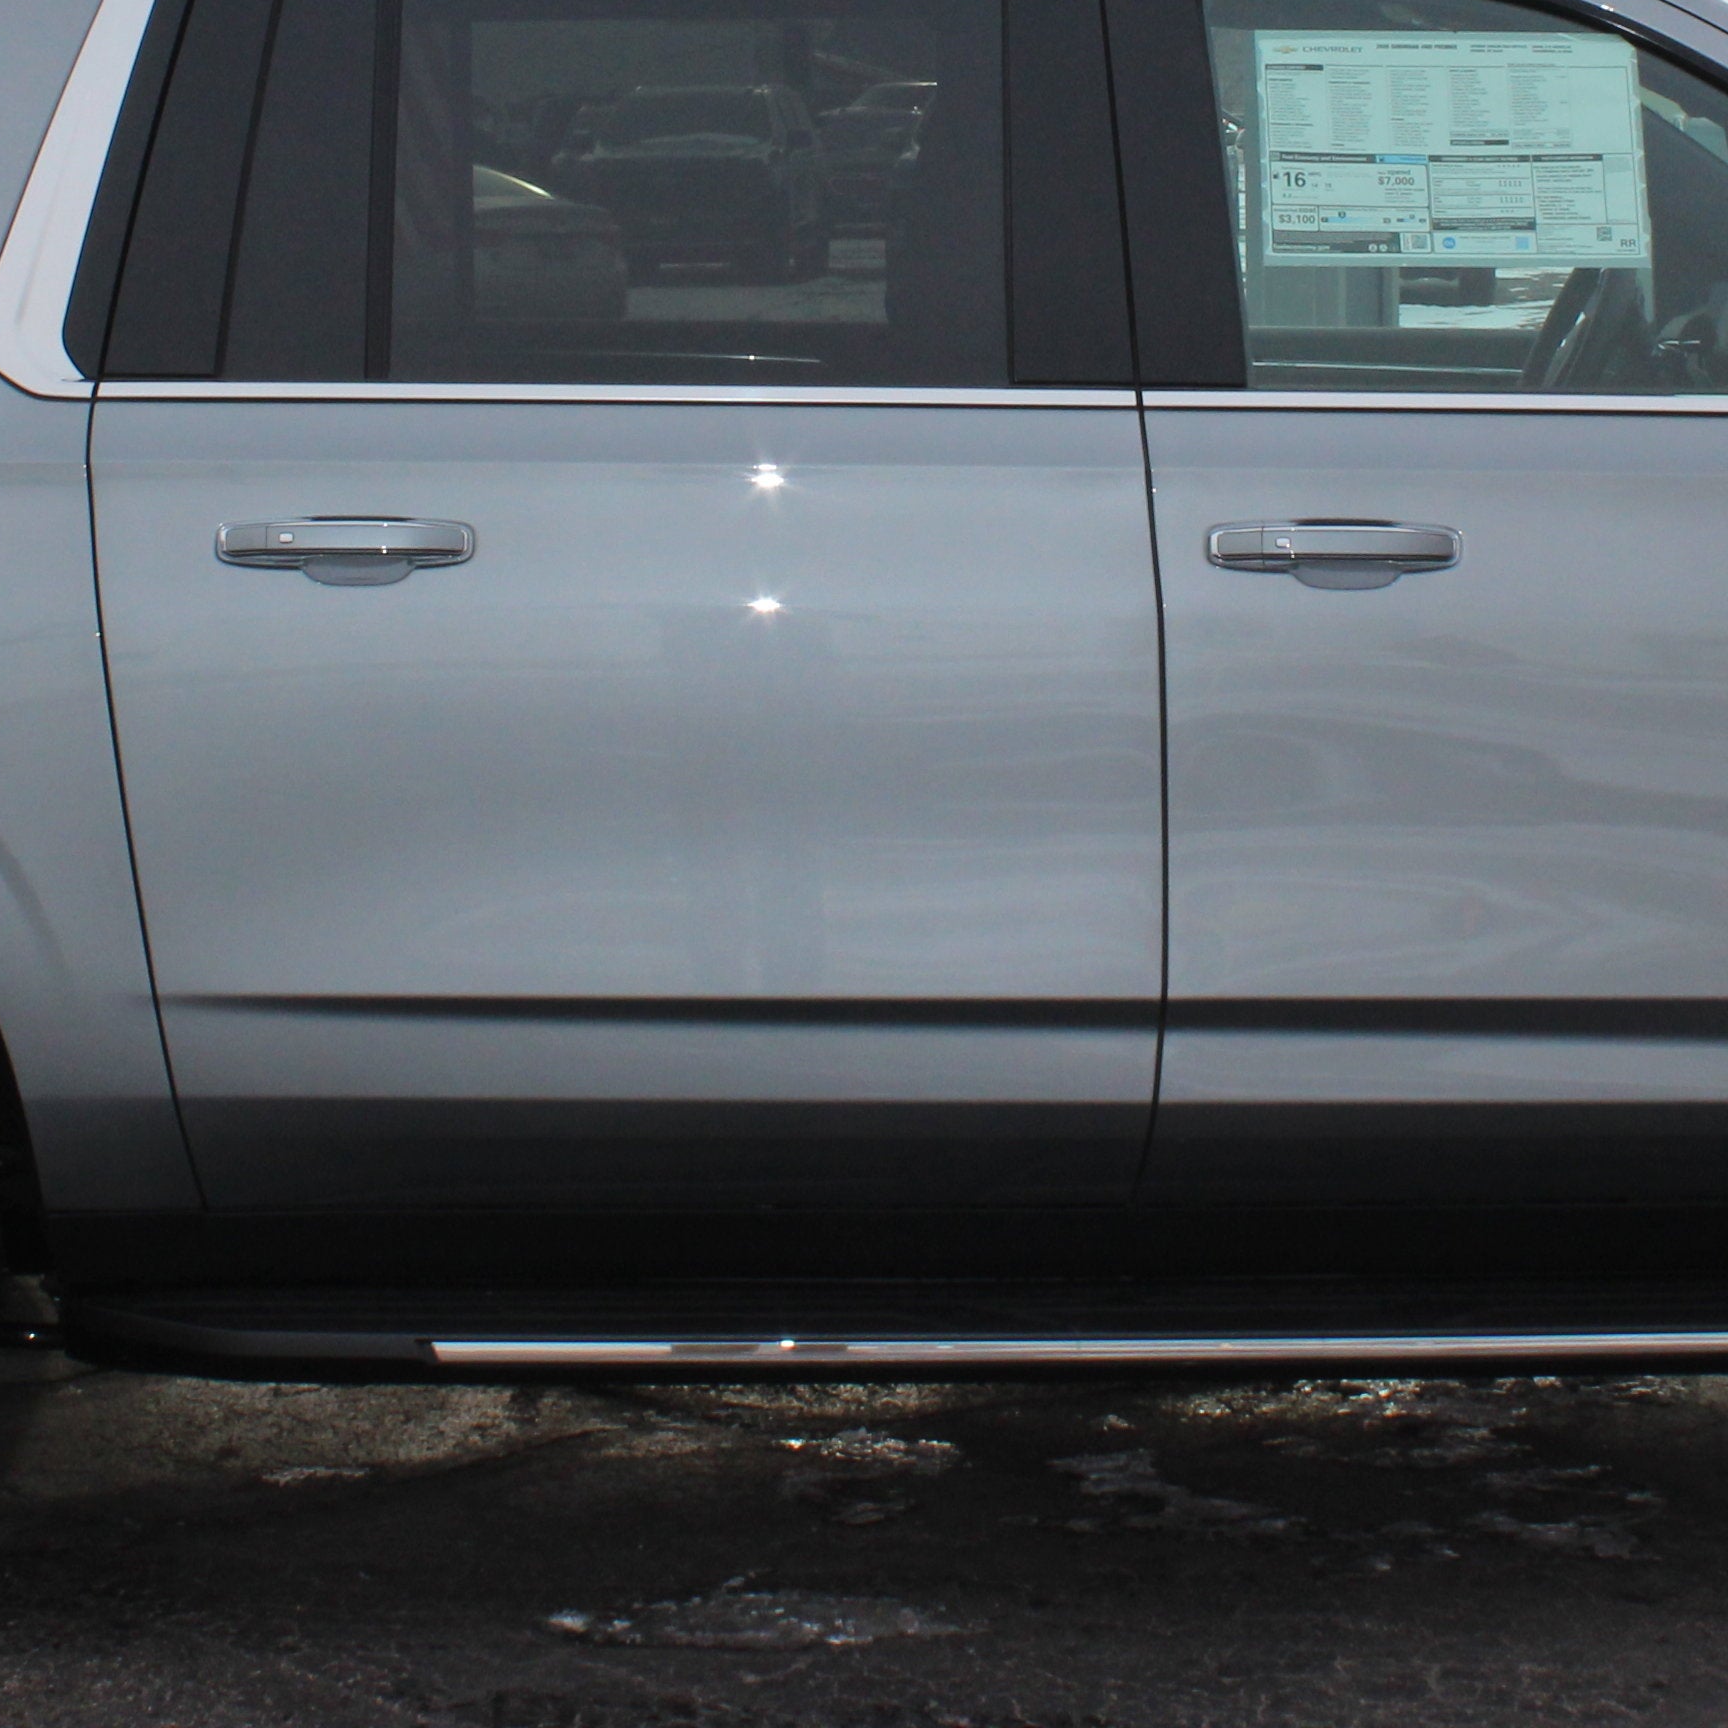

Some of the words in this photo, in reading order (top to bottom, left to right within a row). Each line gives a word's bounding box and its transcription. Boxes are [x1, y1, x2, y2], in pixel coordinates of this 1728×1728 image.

[1283, 171, 1306, 187] 16
[1378, 176, 1415, 187] $7,000
[1278, 214, 1315, 225] $3,100
[1620, 239, 1636, 247] RR
